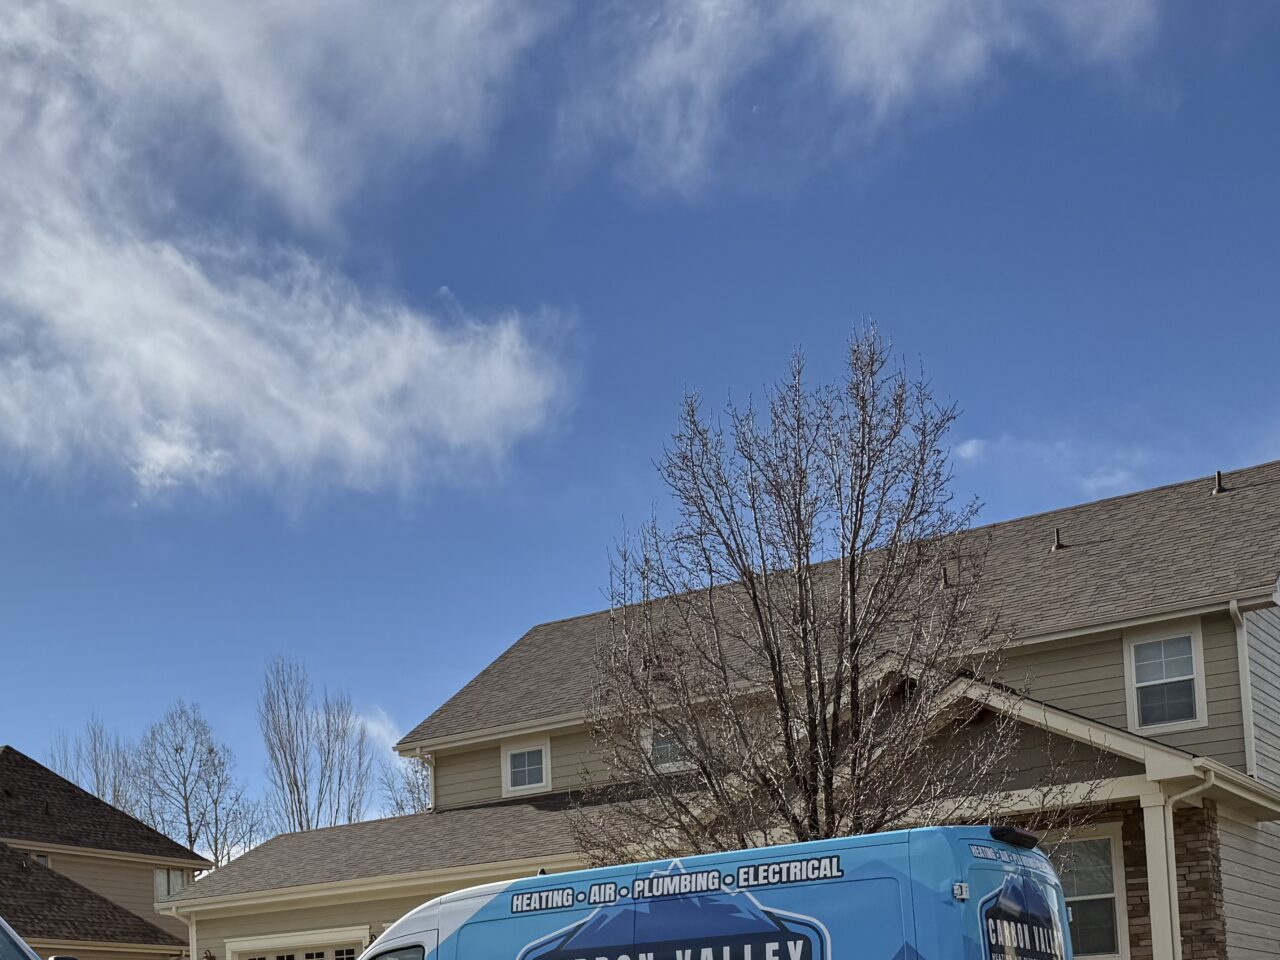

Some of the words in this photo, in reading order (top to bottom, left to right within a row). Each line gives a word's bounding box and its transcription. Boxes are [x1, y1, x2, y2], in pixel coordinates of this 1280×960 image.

[513, 889, 573, 912] HEATING
[589, 884, 617, 902] AIR
[633, 871, 719, 898] PLUMBING
[738, 857, 843, 886] ELECTRICAL
[988, 918, 1031, 950] CARBON
